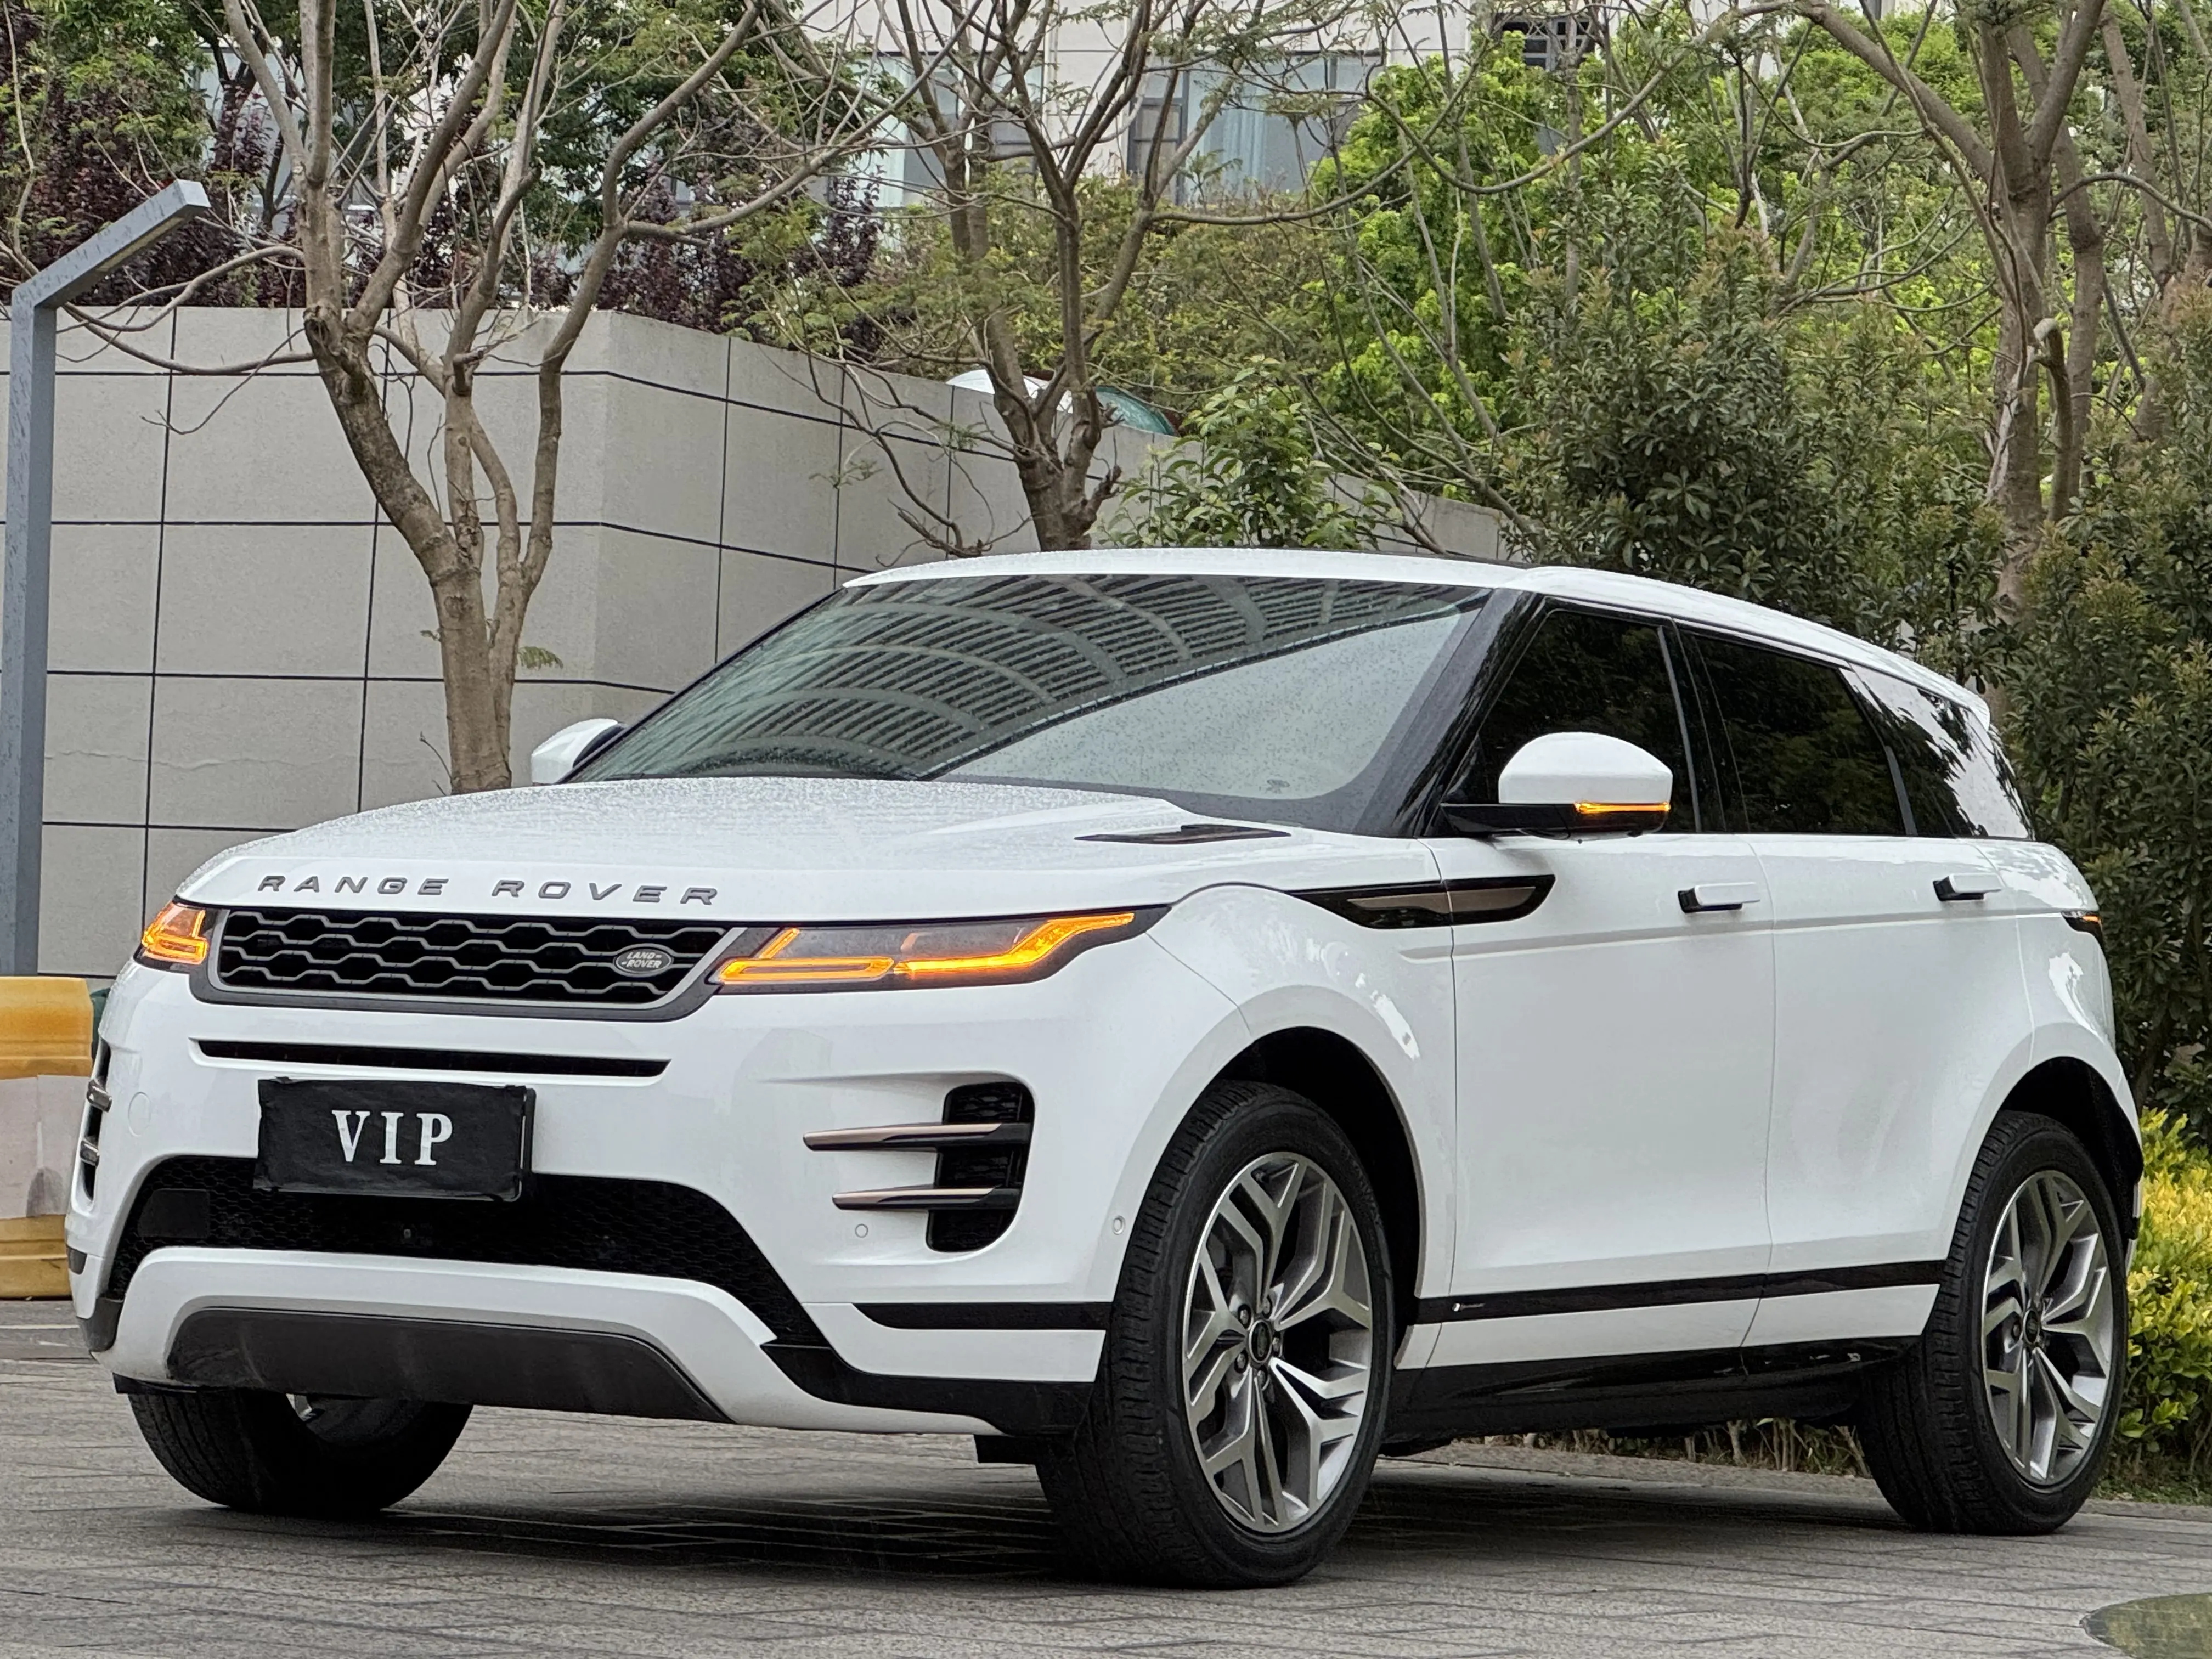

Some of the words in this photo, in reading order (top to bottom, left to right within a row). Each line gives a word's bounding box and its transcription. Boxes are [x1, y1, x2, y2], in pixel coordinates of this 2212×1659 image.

[257, 875, 449, 896] RANGE
[490, 879, 718, 906] ROVER
[331, 1109, 453, 1166] VIP
